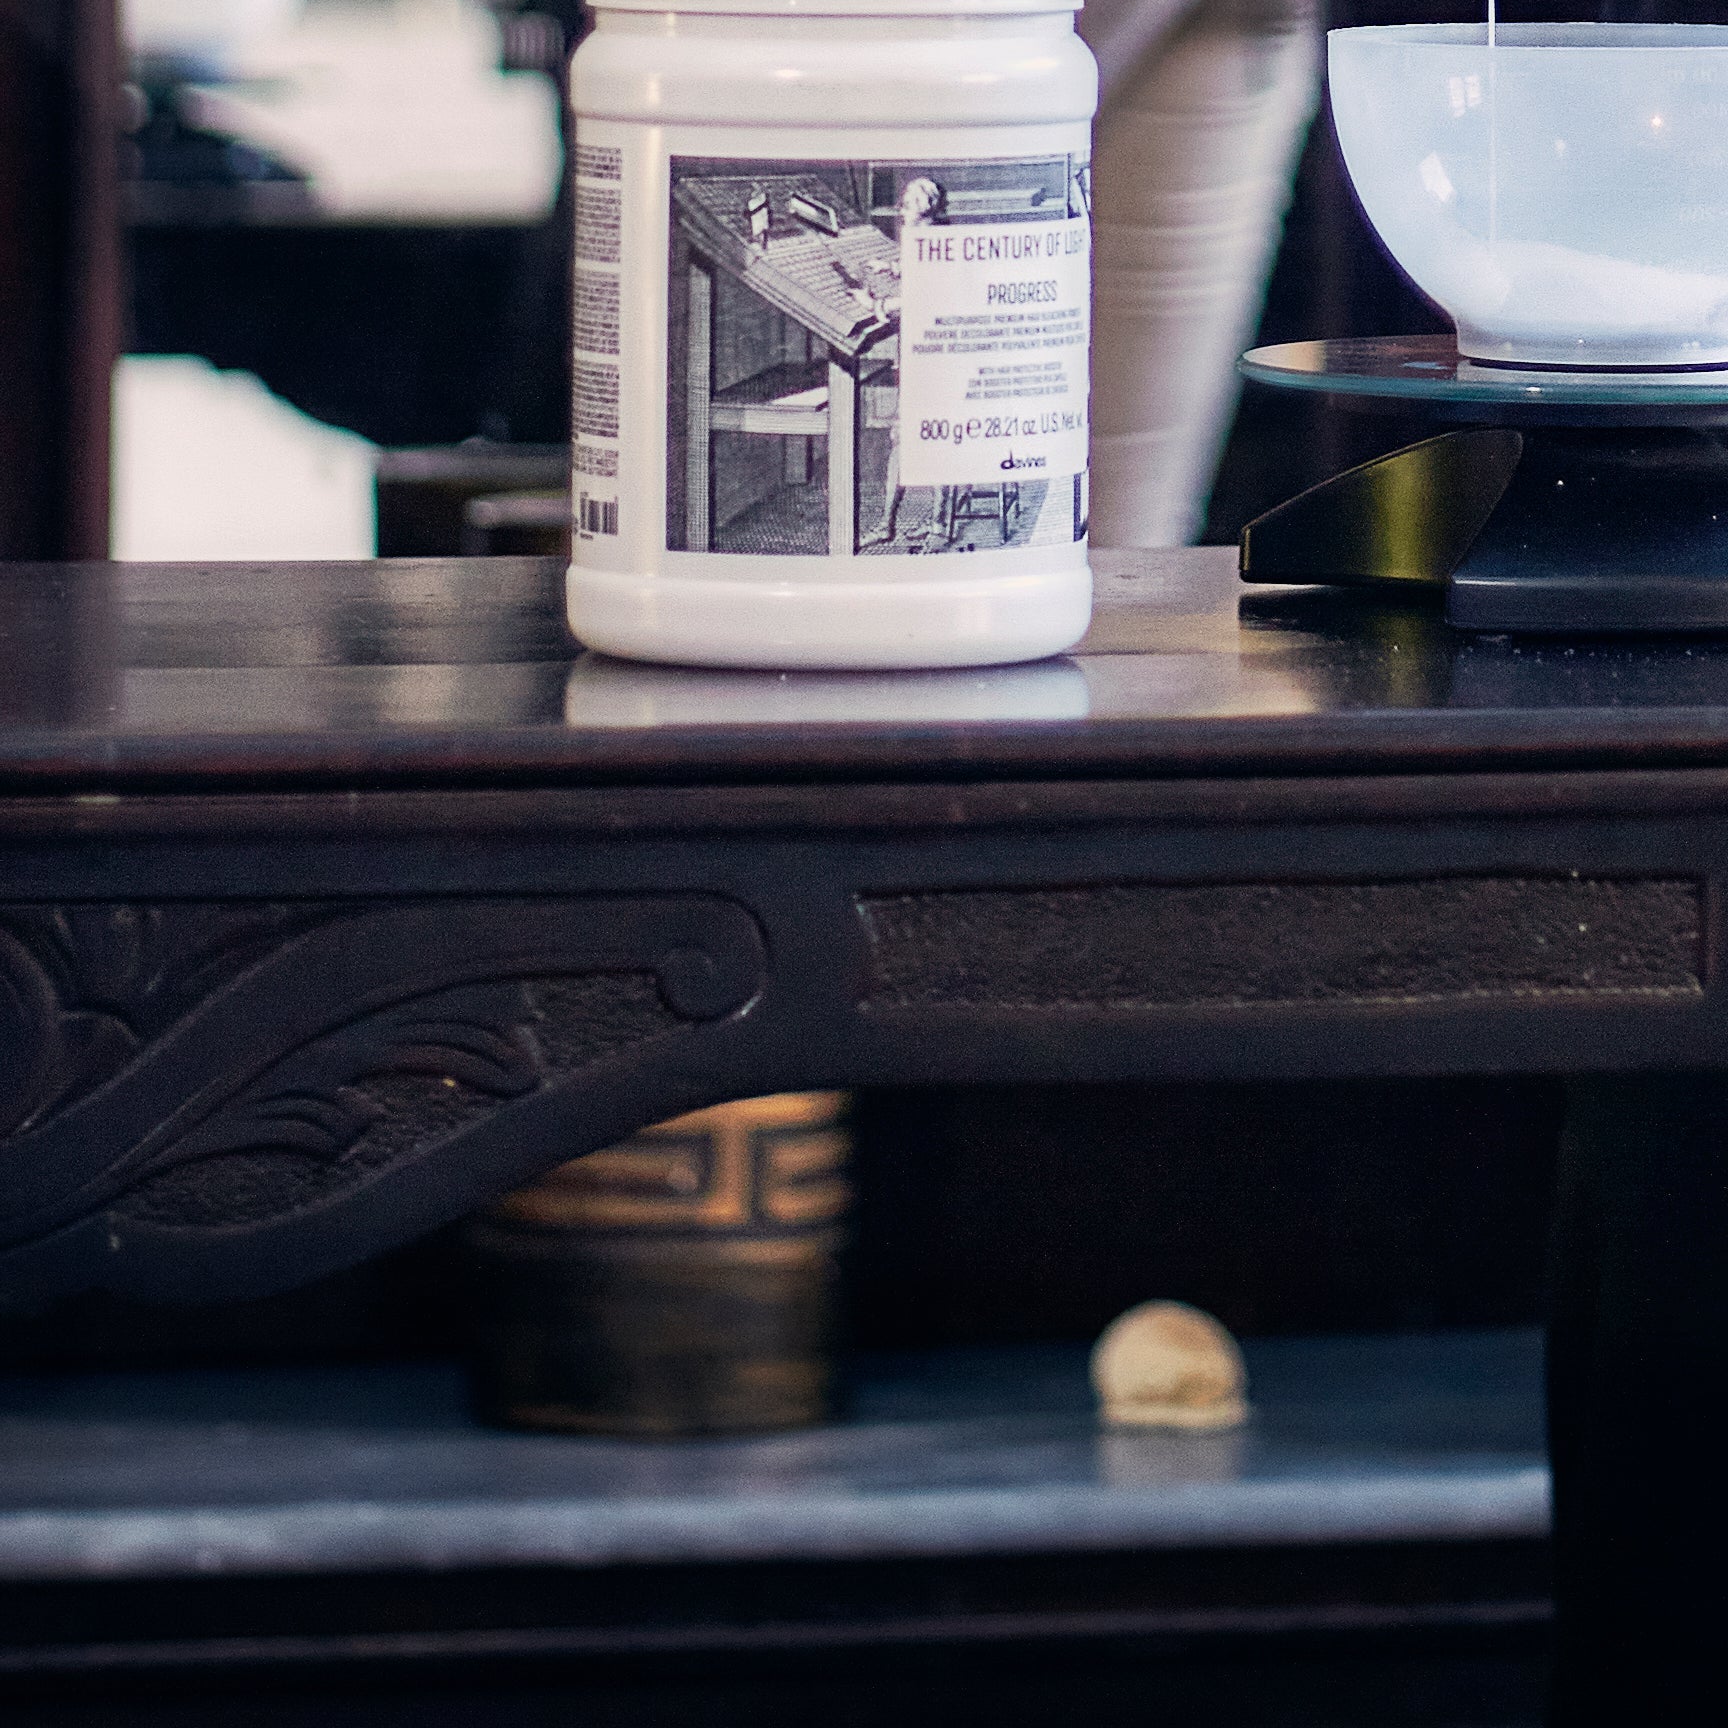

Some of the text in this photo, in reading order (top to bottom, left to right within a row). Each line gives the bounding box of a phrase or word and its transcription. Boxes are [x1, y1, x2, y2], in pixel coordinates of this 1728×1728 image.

[915, 237, 955, 262] THE
[963, 234, 1042, 262] CENTURY
[1046, 232, 1061, 257] OF
[987, 280, 1058, 305] PROGRESS
[920, 419, 949, 441] 800
[953, 422, 963, 444] g
[985, 416, 1019, 438] 28.21
[1000, 448, 1047, 470] davines
